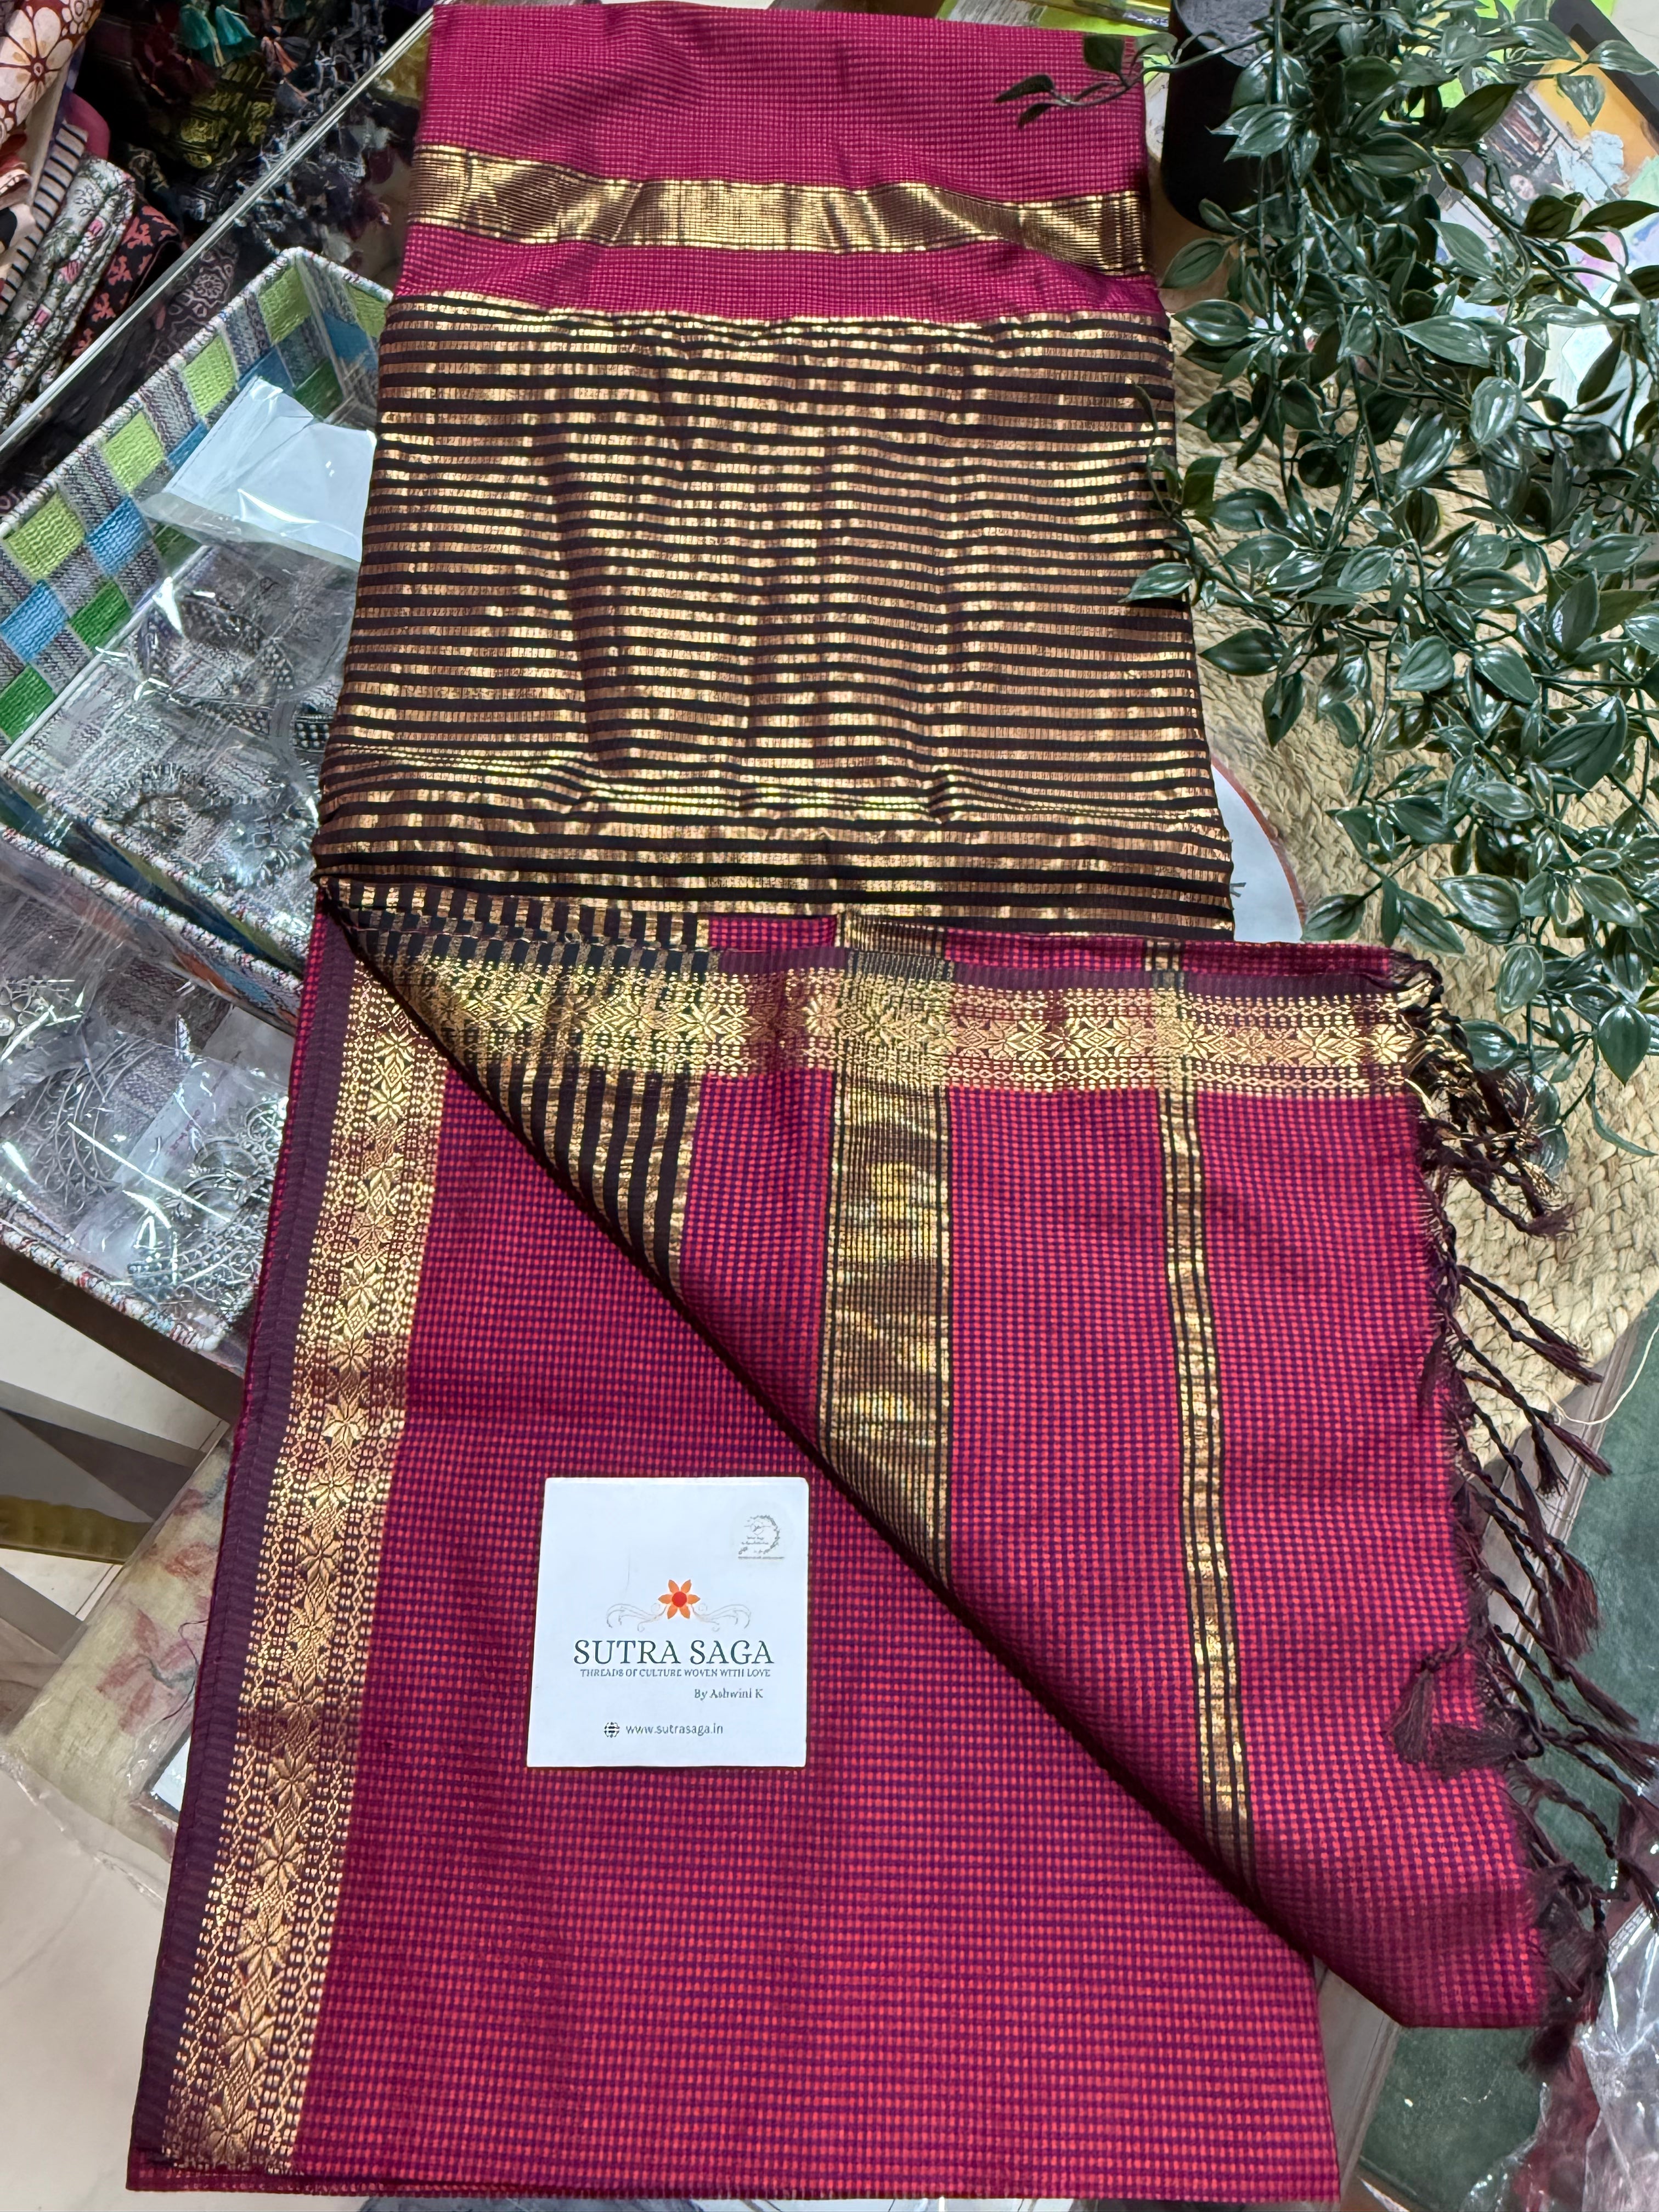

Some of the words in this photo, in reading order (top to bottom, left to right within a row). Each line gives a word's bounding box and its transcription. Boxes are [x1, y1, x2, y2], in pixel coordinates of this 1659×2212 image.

[574, 1640, 681, 1664] SUTRA
[689, 1640, 775, 1665] SAGA
[580, 1669, 624, 1677] THREADS
[720, 1669, 744, 1677] WITH
[747, 1669, 770, 1677] LOVE
[695, 1689, 708, 1701] By
[709, 1688, 752, 1699] Ashwini
[755, 1689, 763, 1699] K
[626, 1723, 723, 1736] www.sutrasaga.in
